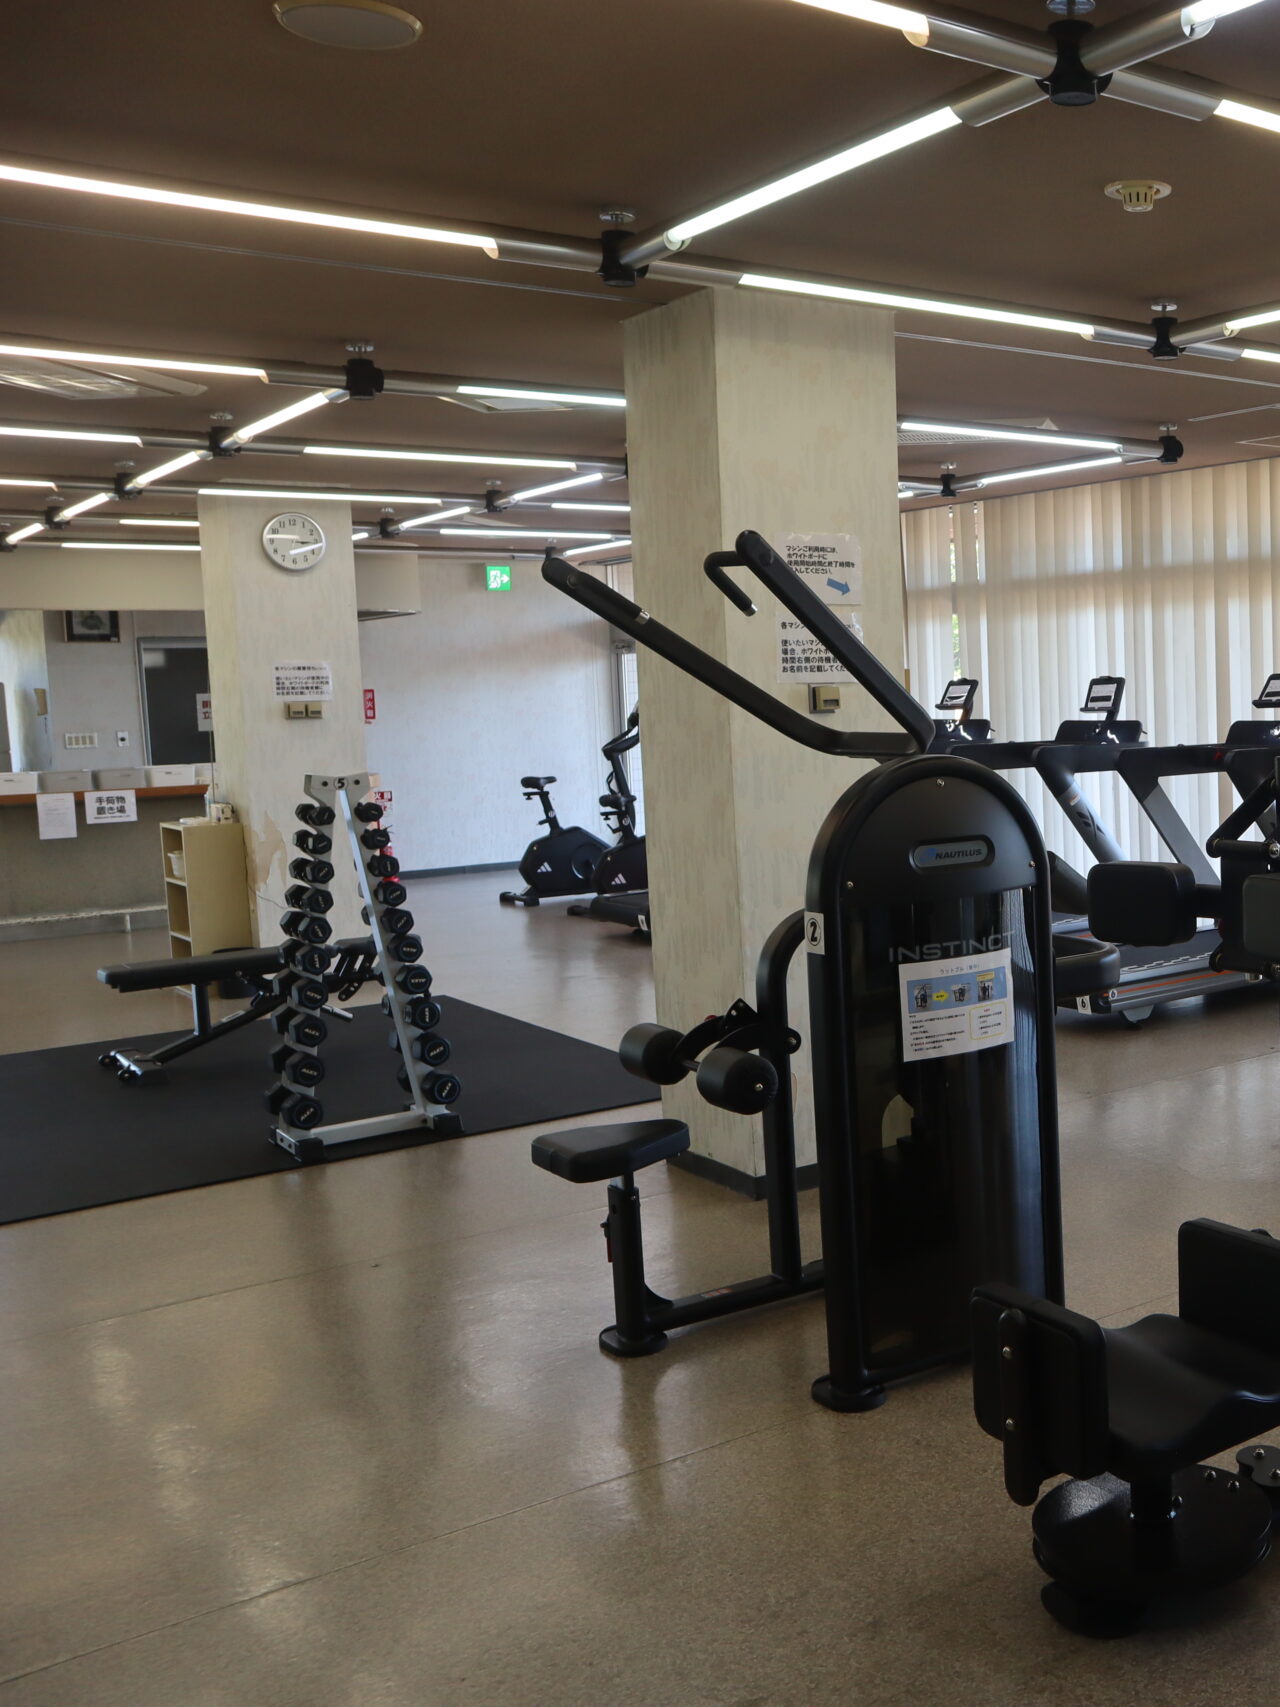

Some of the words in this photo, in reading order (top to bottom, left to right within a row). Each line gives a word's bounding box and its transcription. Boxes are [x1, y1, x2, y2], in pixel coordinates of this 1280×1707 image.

[95, 796, 127, 806] 手荷物
[96, 805, 127, 816] 置き場
[935, 848, 983, 860] NAUTILUS
[889, 930, 1015, 963] INSTINCT
